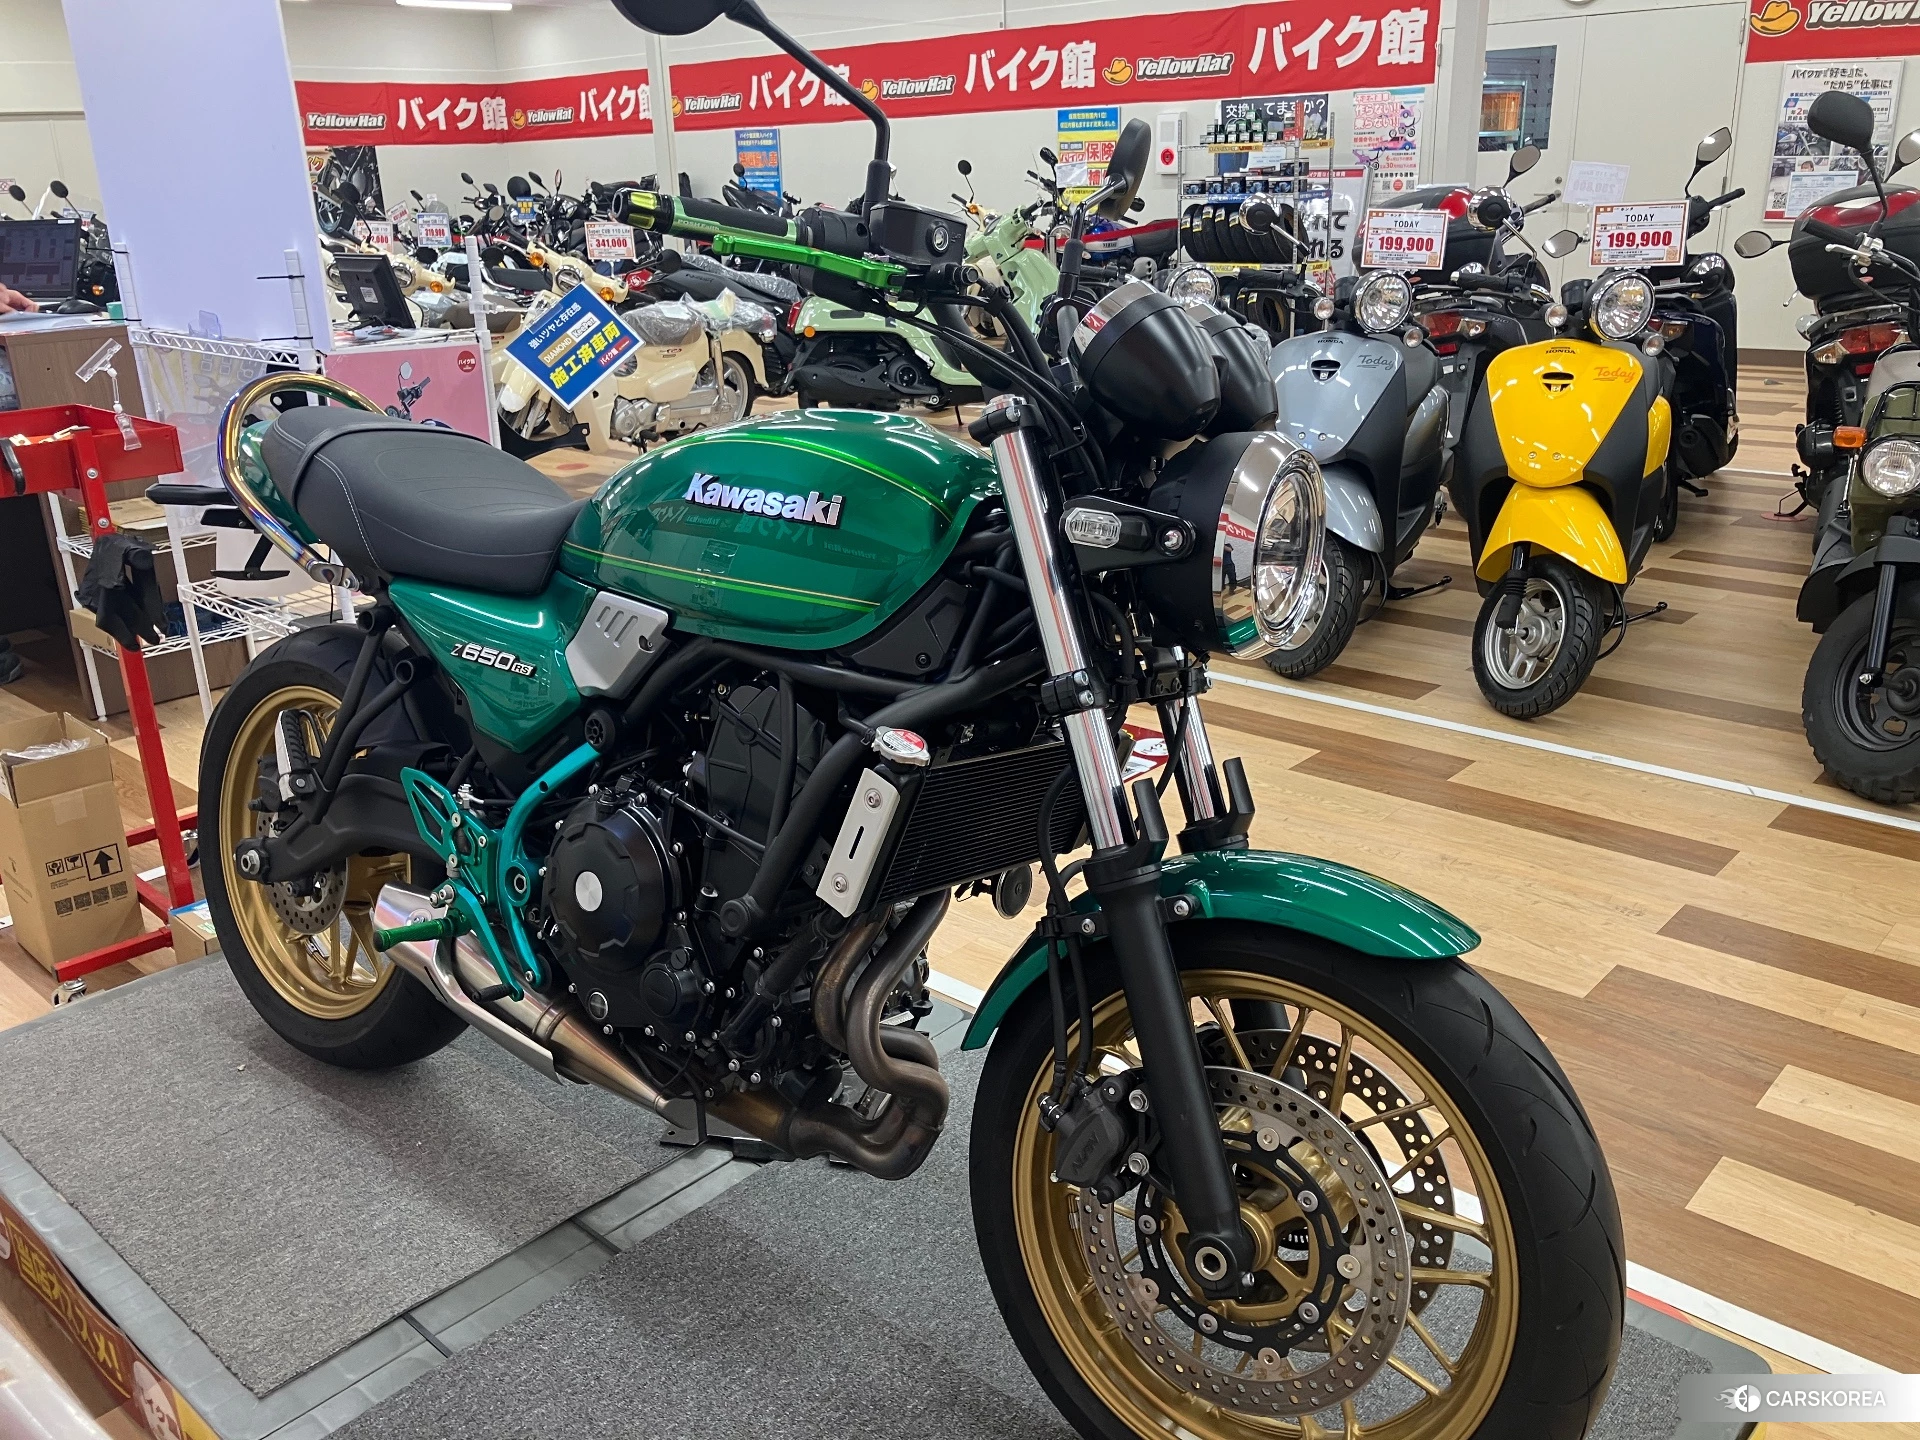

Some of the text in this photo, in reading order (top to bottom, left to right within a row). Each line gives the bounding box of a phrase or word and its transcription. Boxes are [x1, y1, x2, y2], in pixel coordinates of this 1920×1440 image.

[1248, 7, 1428, 74] バイク館
[964, 40, 1096, 93] バイク館
[1137, 53, 1233, 81] YellowHat
[882, 76, 954, 98] YellowHat
[685, 94, 741, 113] YellowHat
[308, 114, 385, 129] YellowHat
[397, 97, 508, 130] バイク館
[527, 108, 573, 125] YellowHat
[1394, 220, 1419, 228] TODAY
[1625, 214, 1655, 222] TODAY
[595, 239, 627, 248] 341,000
[1378, 236, 1434, 252] 199,900
[1607, 231, 1673, 249] 199,900
[543, 337, 572, 364] DIAMOND
[549, 320, 621, 390] 施工済車両
[1358, 354, 1395, 371] Today
[1594, 366, 1636, 383] Today
[683, 472, 843, 527] Kawasaki
